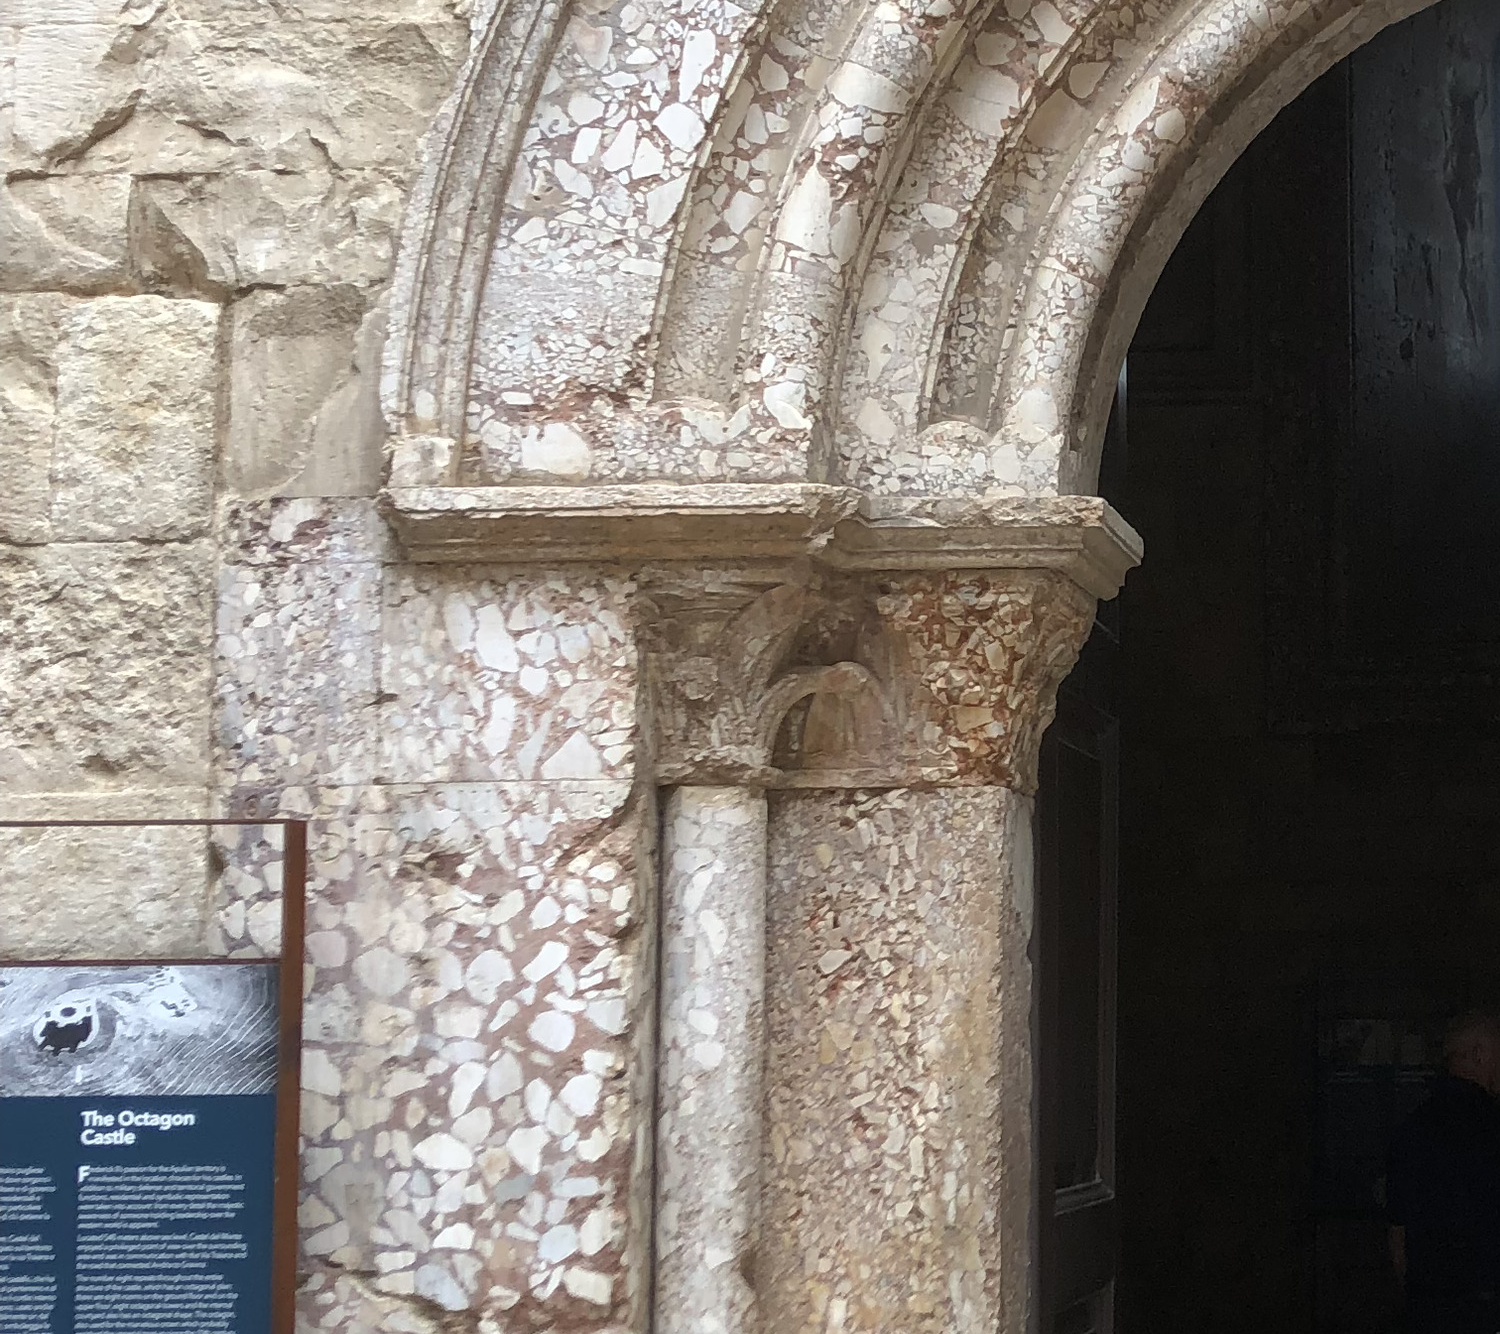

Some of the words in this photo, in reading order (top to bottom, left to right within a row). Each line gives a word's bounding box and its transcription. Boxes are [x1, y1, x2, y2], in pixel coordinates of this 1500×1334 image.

[81, 1110, 114, 1127] The
[118, 1110, 195, 1130] Octagon
[80, 1129, 136, 1145] Castle
